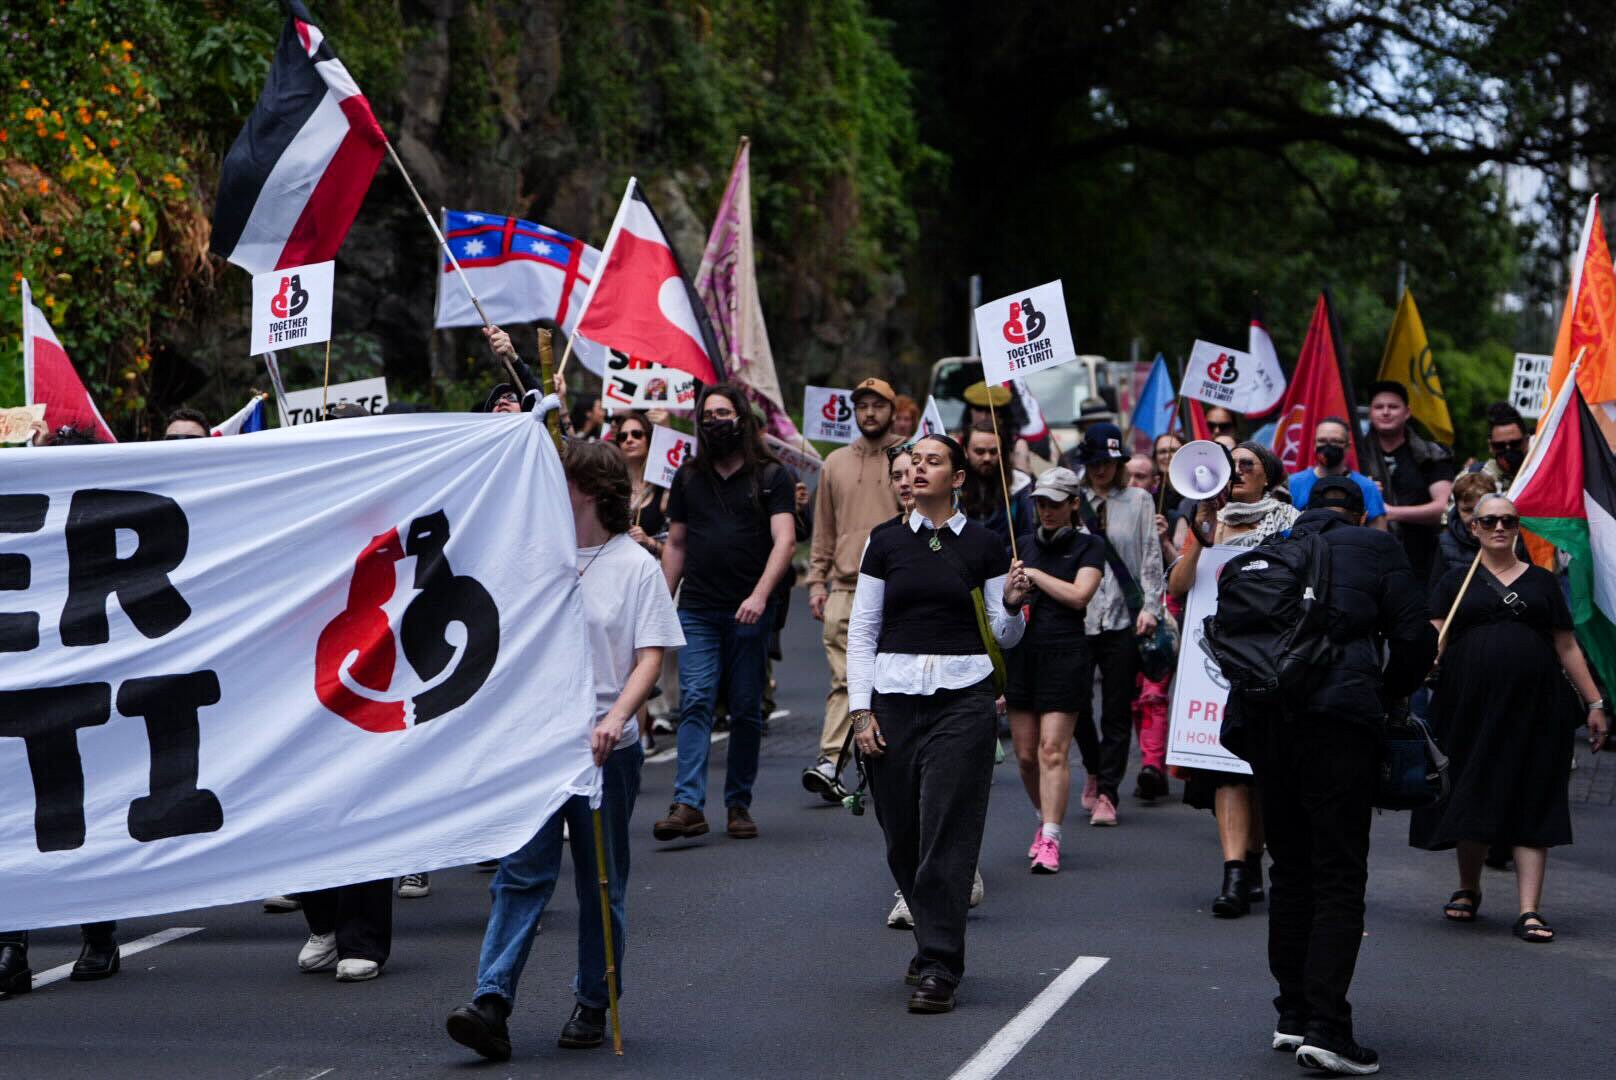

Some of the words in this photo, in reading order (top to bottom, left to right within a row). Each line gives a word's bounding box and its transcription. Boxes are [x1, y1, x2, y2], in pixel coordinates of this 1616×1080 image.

[269, 316, 308, 333] TOGETHER
[275, 332, 283, 343] TE
[285, 327, 307, 341] TIRITI
[1007, 338, 1052, 360] TOGETHER
[1015, 357, 1028, 369] TE
[1028, 348, 1054, 366] TIRITI
